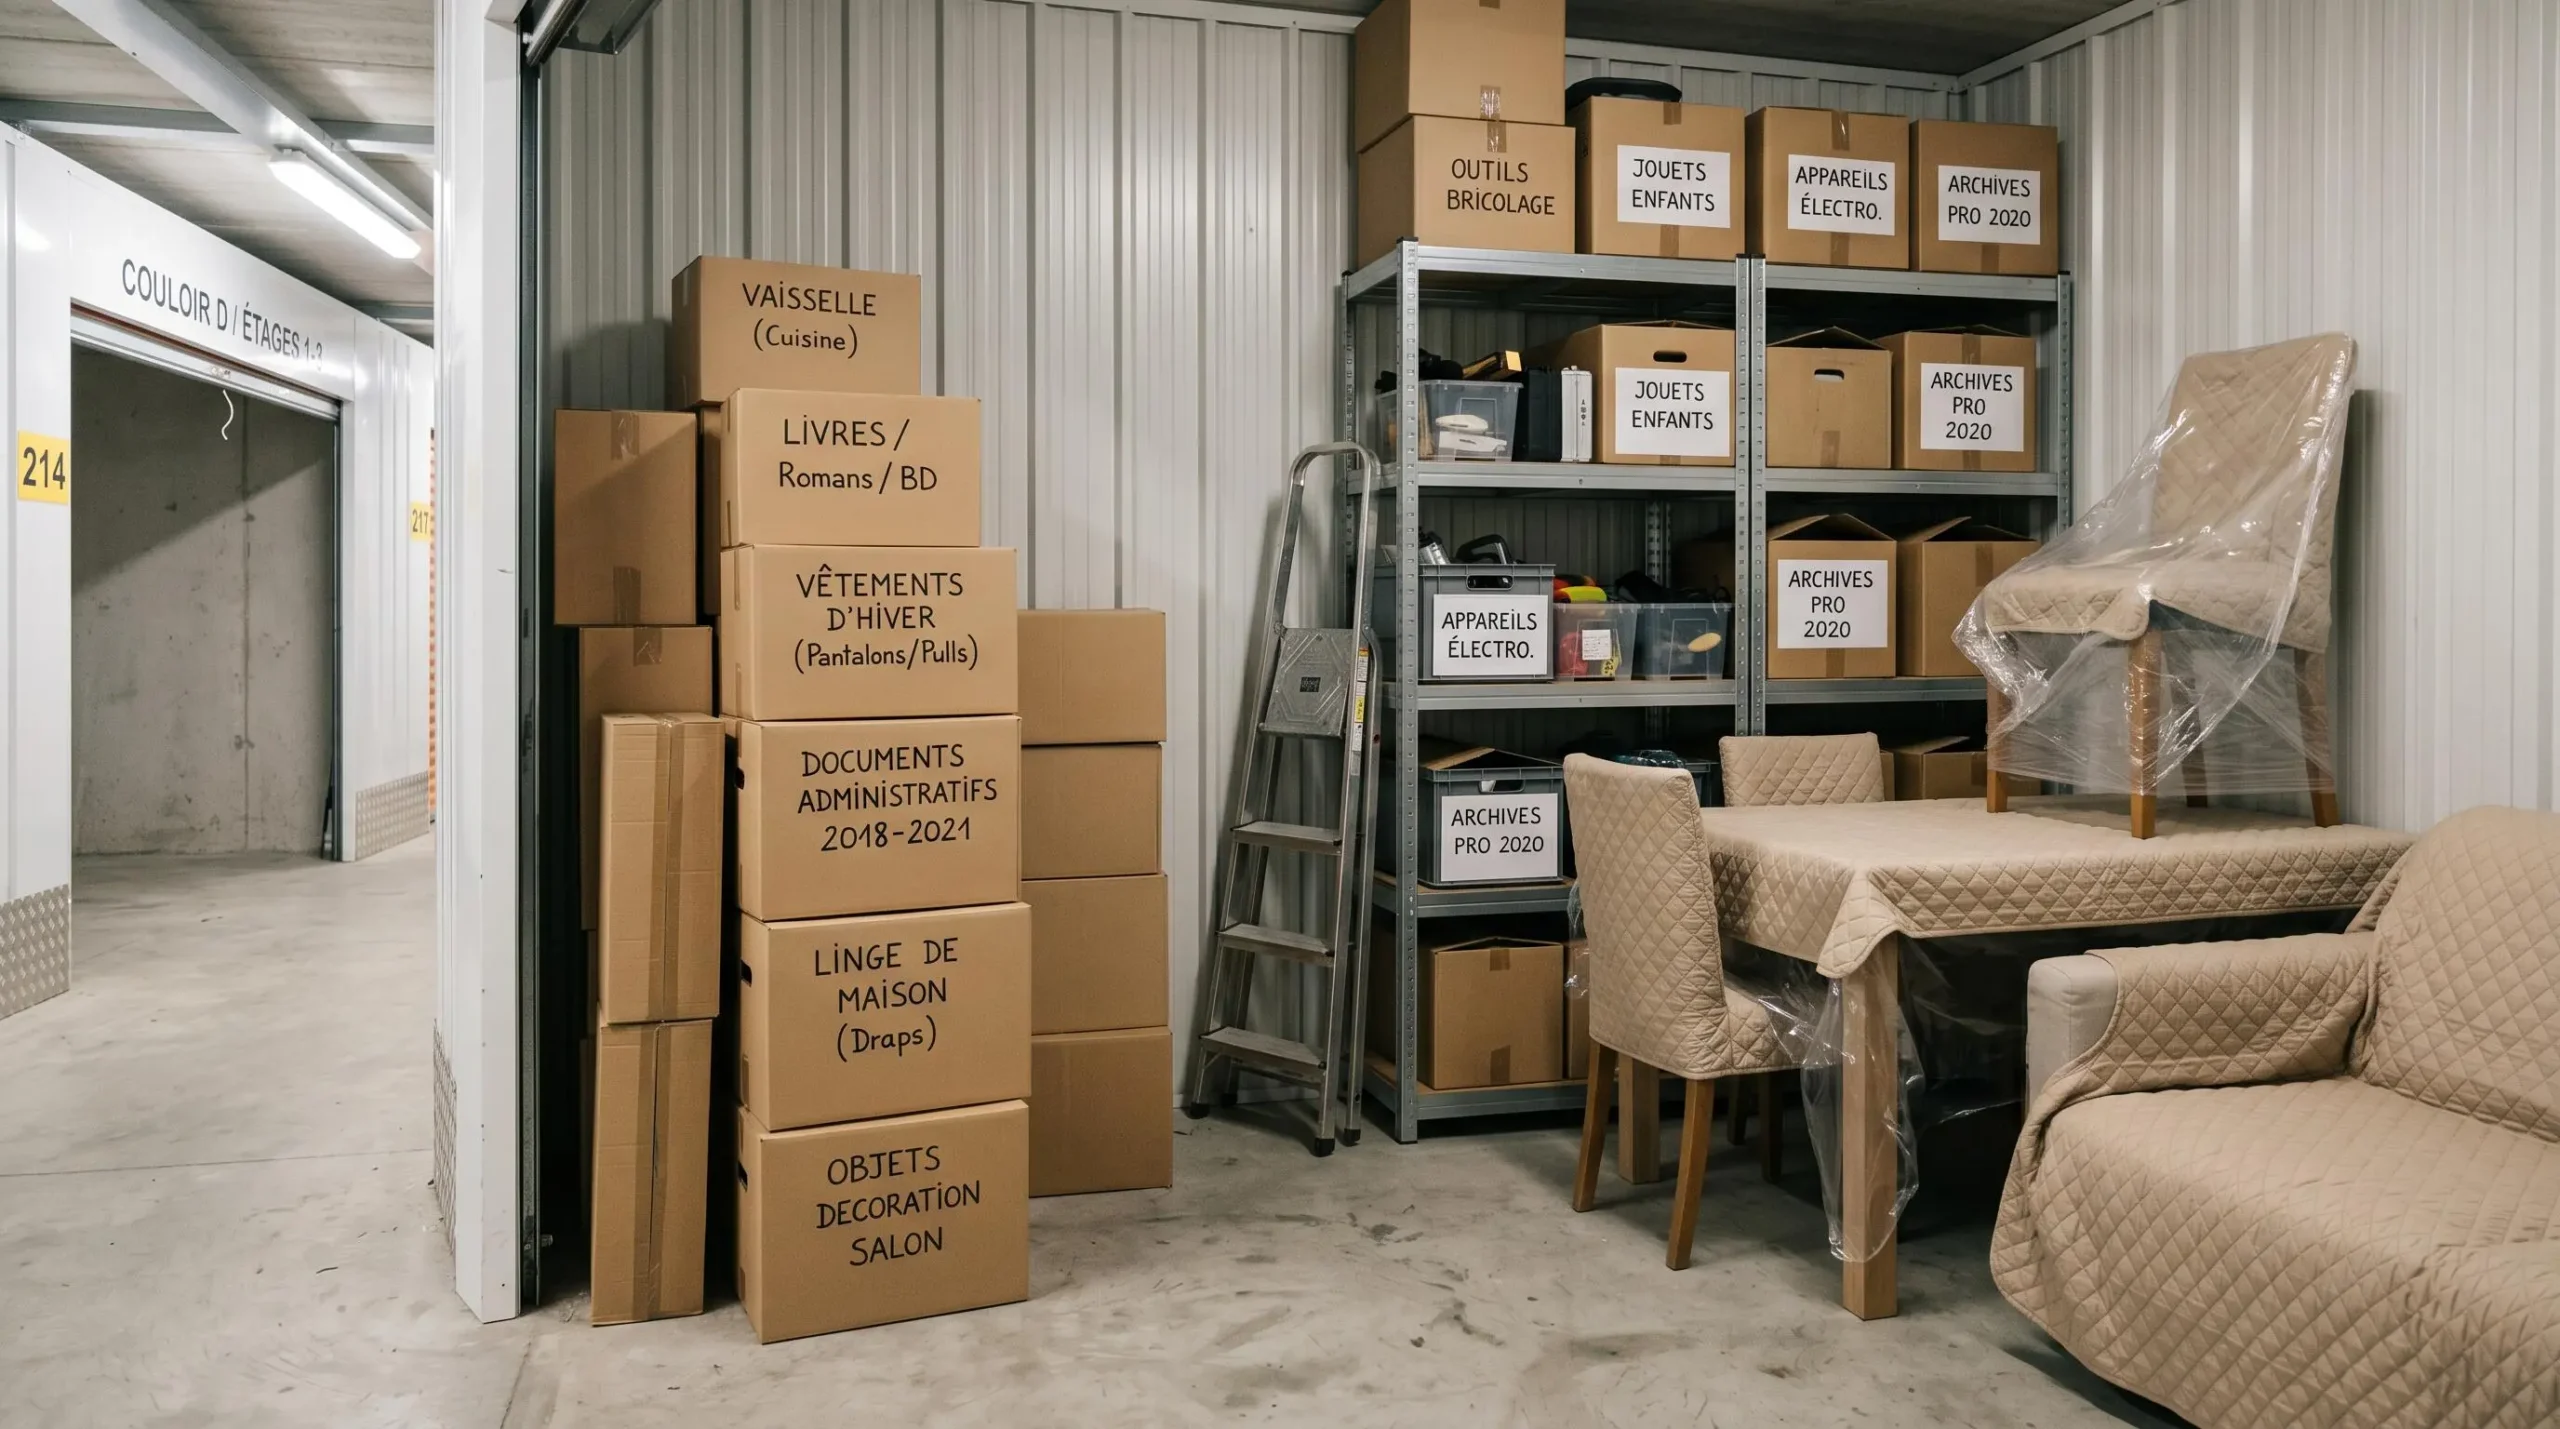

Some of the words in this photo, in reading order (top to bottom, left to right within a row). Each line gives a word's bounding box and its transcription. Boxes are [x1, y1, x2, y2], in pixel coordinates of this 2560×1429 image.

[1451, 157, 1529, 183] OUTILS
[1632, 158, 1707, 182] JOUETS
[1795, 166, 1888, 191] APPAREILS
[1632, 188, 1715, 212] ENFANTS
[1947, 175, 2031, 198] ARCHIVES
[1447, 187, 1555, 216] BRICOLAGE
[1801, 192, 1882, 221] ÉLECTRO.
[1948, 205, 1981, 225] PRO
[1988, 208, 2031, 228] 2020
[121, 258, 211, 326] COULOIR
[217, 298, 228, 331] D
[232, 304, 238, 336] /
[242, 301, 301, 359] ÉTAGES
[741, 280, 877, 317] VAISSELLE
[753, 318, 858, 359] (Cuisine)
[1634, 380, 1705, 402] JOUETS
[1930, 371, 2013, 393] ARCHIVES
[1632, 409, 1714, 431] ENFANTS
[1952, 396, 1986, 416] PRO
[784, 414, 886, 447] LIVRES
[893, 418, 910, 452] /
[1945, 421, 1992, 441] 2020
[22, 446, 66, 490] 214
[779, 461, 873, 490] Romans
[878, 461, 893, 495] /
[901, 465, 938, 491] BD
[412, 508, 429, 534] 217
[795, 563, 964, 599] VÊTEMENTS
[1788, 570, 1874, 588] ARCHIVES
[826, 601, 936, 632] D'HIVER
[1811, 595, 1846, 614] PRO
[1441, 609, 1538, 631] APPAREILS
[1803, 620, 1851, 638] 2020
[794, 633, 978, 675] (Pantalons/Pulls)
[1448, 634, 1534, 659] ÉLECTRO.
[801, 743, 965, 778] DOCUMENTS
[797, 775, 998, 814] ADMINISTRATIFS
[1450, 806, 1541, 827] ARCHIVES
[820, 816, 970, 852] 2018-2021
[1454, 836, 1491, 855] PRO
[1499, 835, 1544, 854] 2020
[815, 942, 902, 977] LINGE
[923, 937, 959, 965] DE
[838, 977, 947, 1014] MAISON
[837, 1014, 937, 1063] (Draps)
[827, 1145, 942, 1186] OBJETS
[816, 1180, 981, 1230] DECORATION
[849, 1226, 943, 1267] SALON
